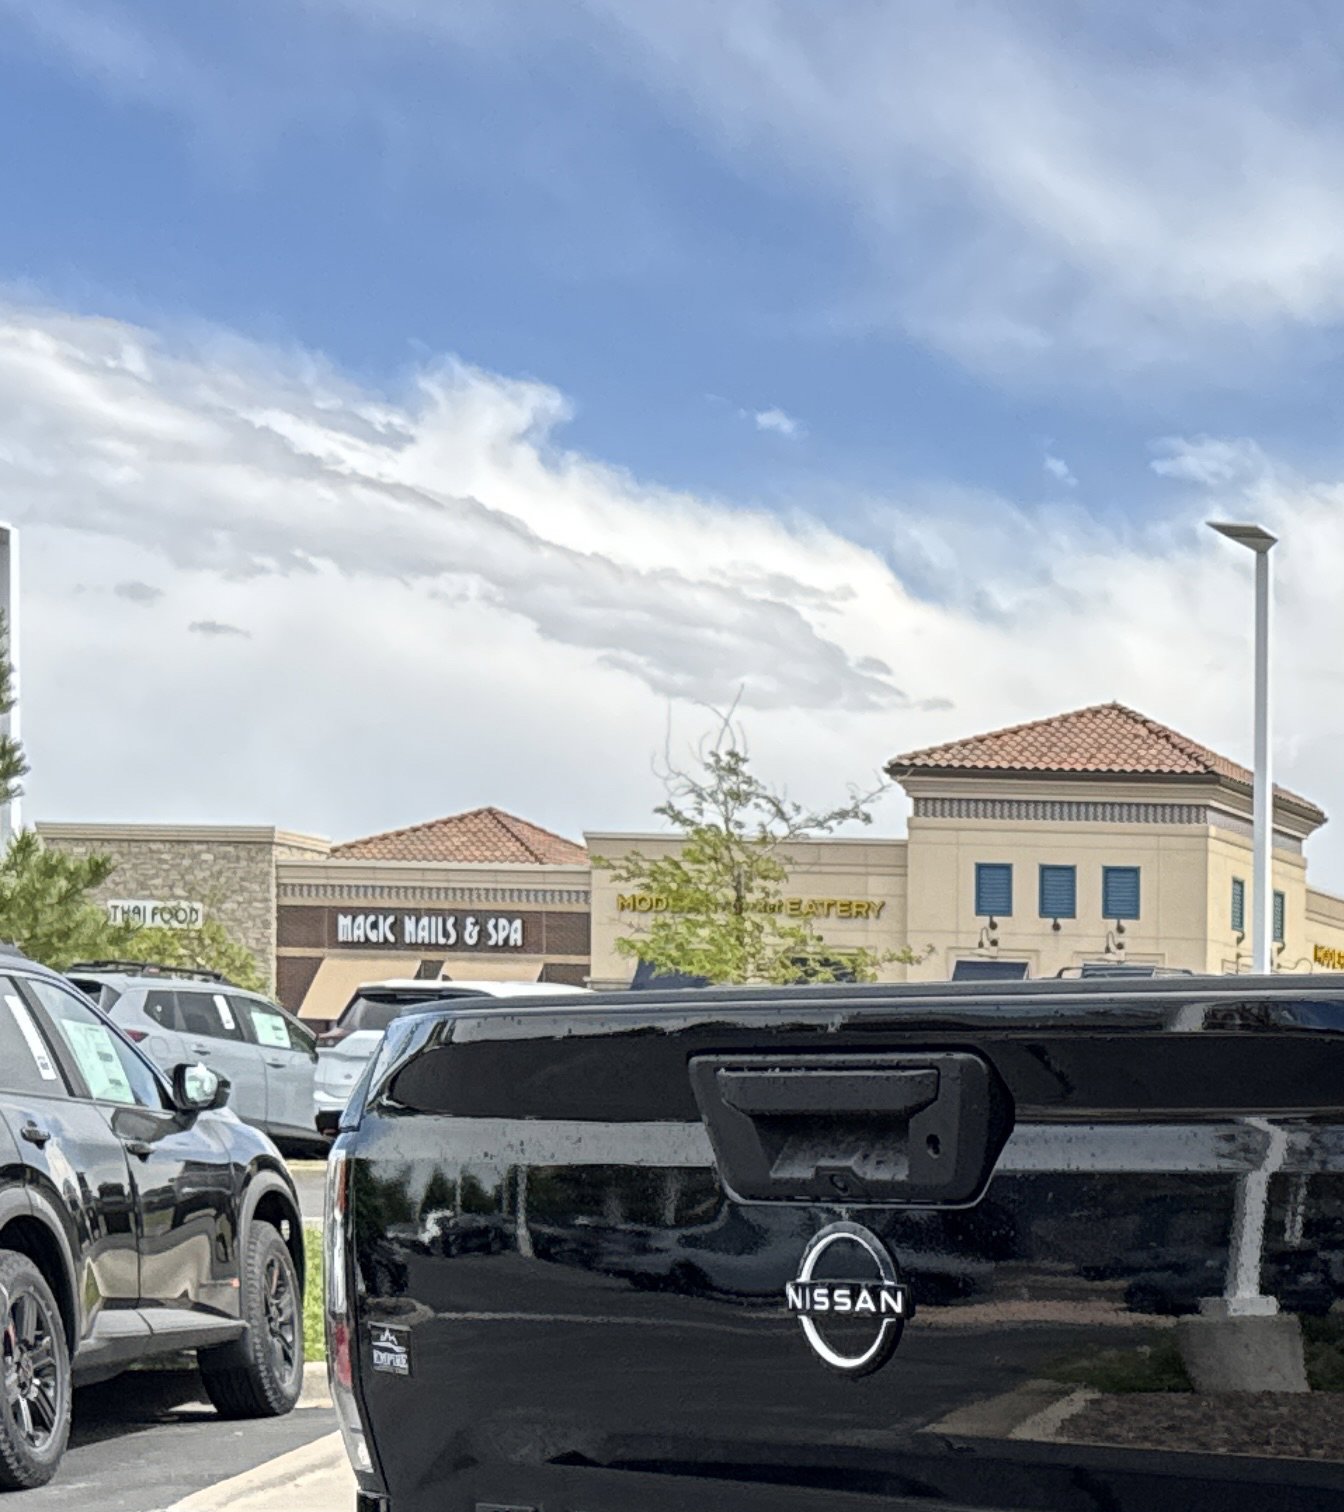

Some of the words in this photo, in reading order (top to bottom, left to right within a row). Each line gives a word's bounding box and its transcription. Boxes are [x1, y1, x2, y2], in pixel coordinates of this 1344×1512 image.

[110, 904, 147, 923] THAI
[151, 905, 199, 925] FOOD
[783, 898, 887, 920] EATERY
[337, 912, 396, 943] MAGIC
[403, 914, 458, 946] NAILS
[463, 916, 481, 946] &
[486, 917, 524, 947] SPA
[786, 1285, 903, 1314] NISSAN
